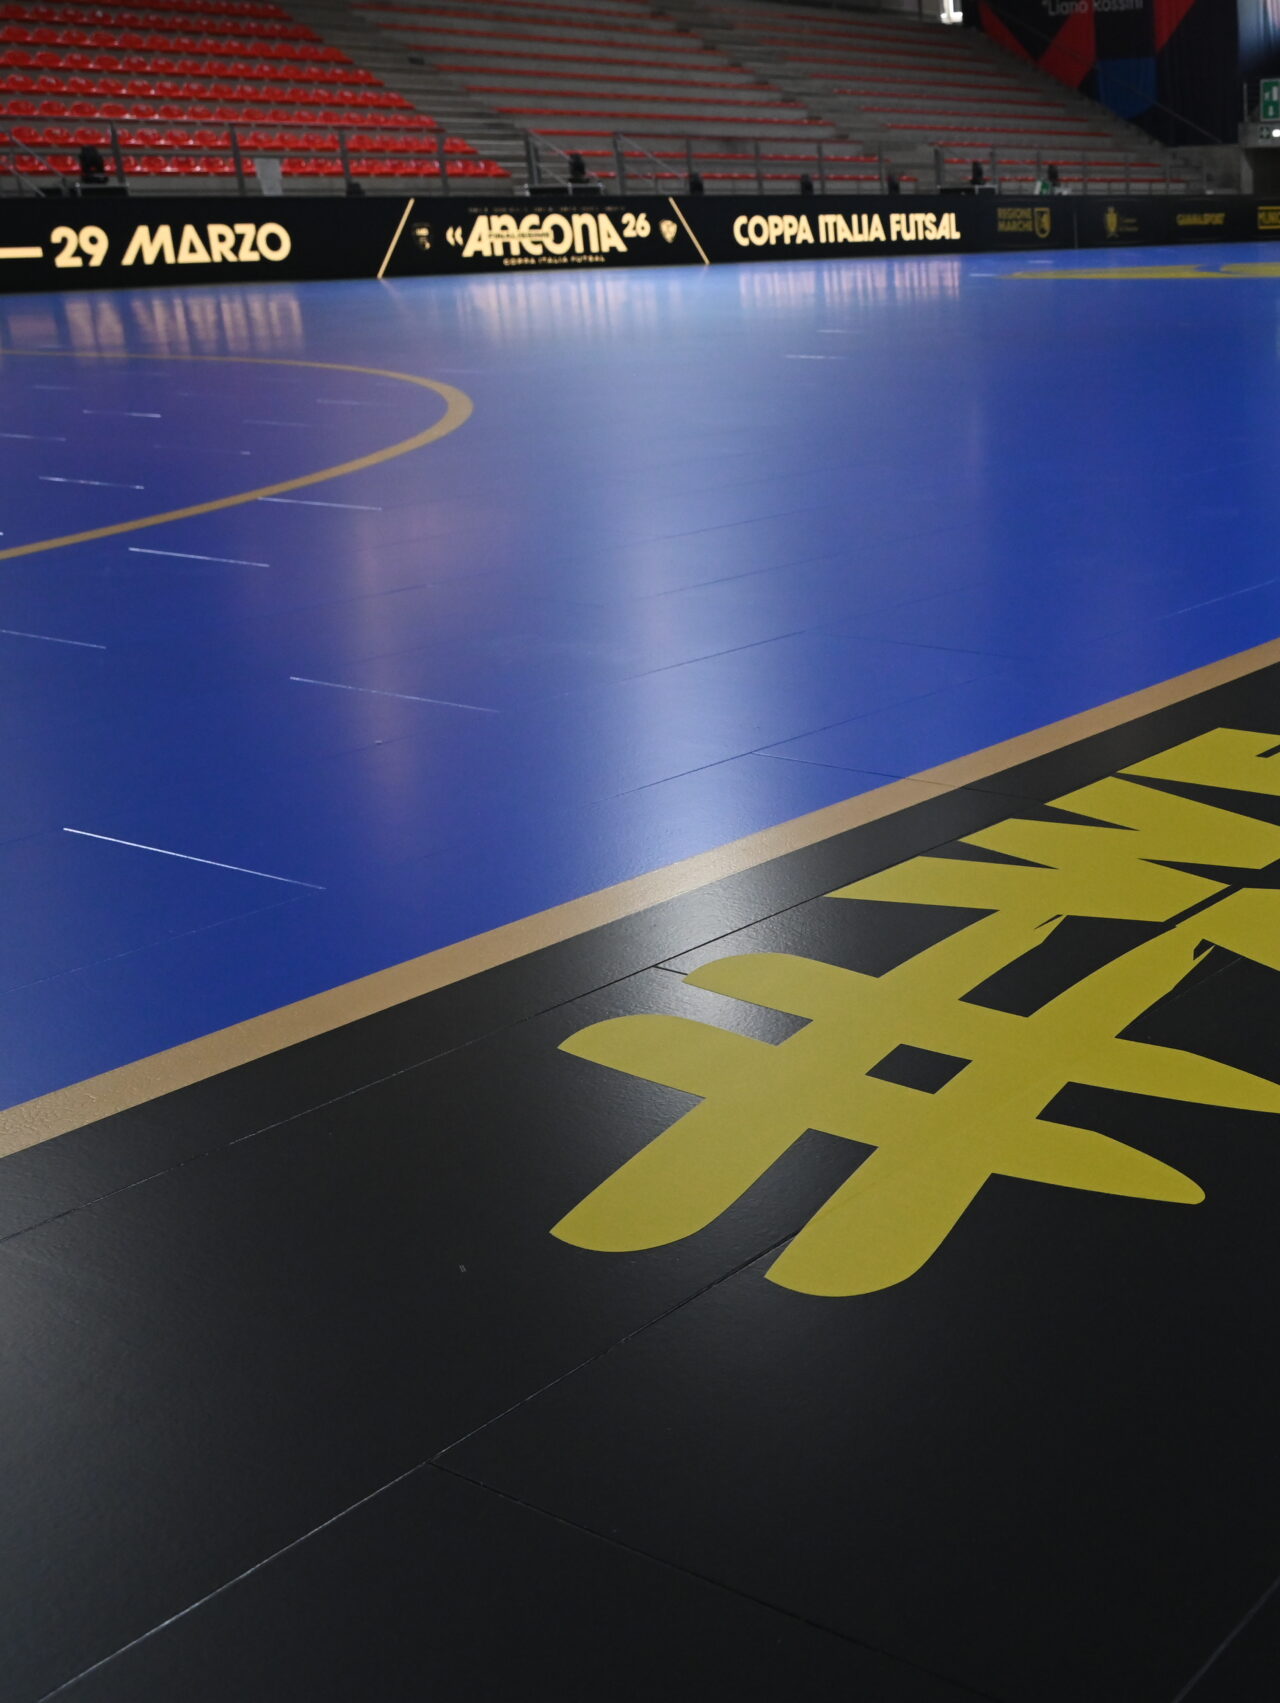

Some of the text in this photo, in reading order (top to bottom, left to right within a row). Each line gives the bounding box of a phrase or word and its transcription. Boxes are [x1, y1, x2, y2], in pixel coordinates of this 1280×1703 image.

[50, 222, 291, 268] 29 MARZO
[461, 212, 651, 257] ANCONA 26
[733, 212, 961, 247] COPPA ITALIA FUTSAL
